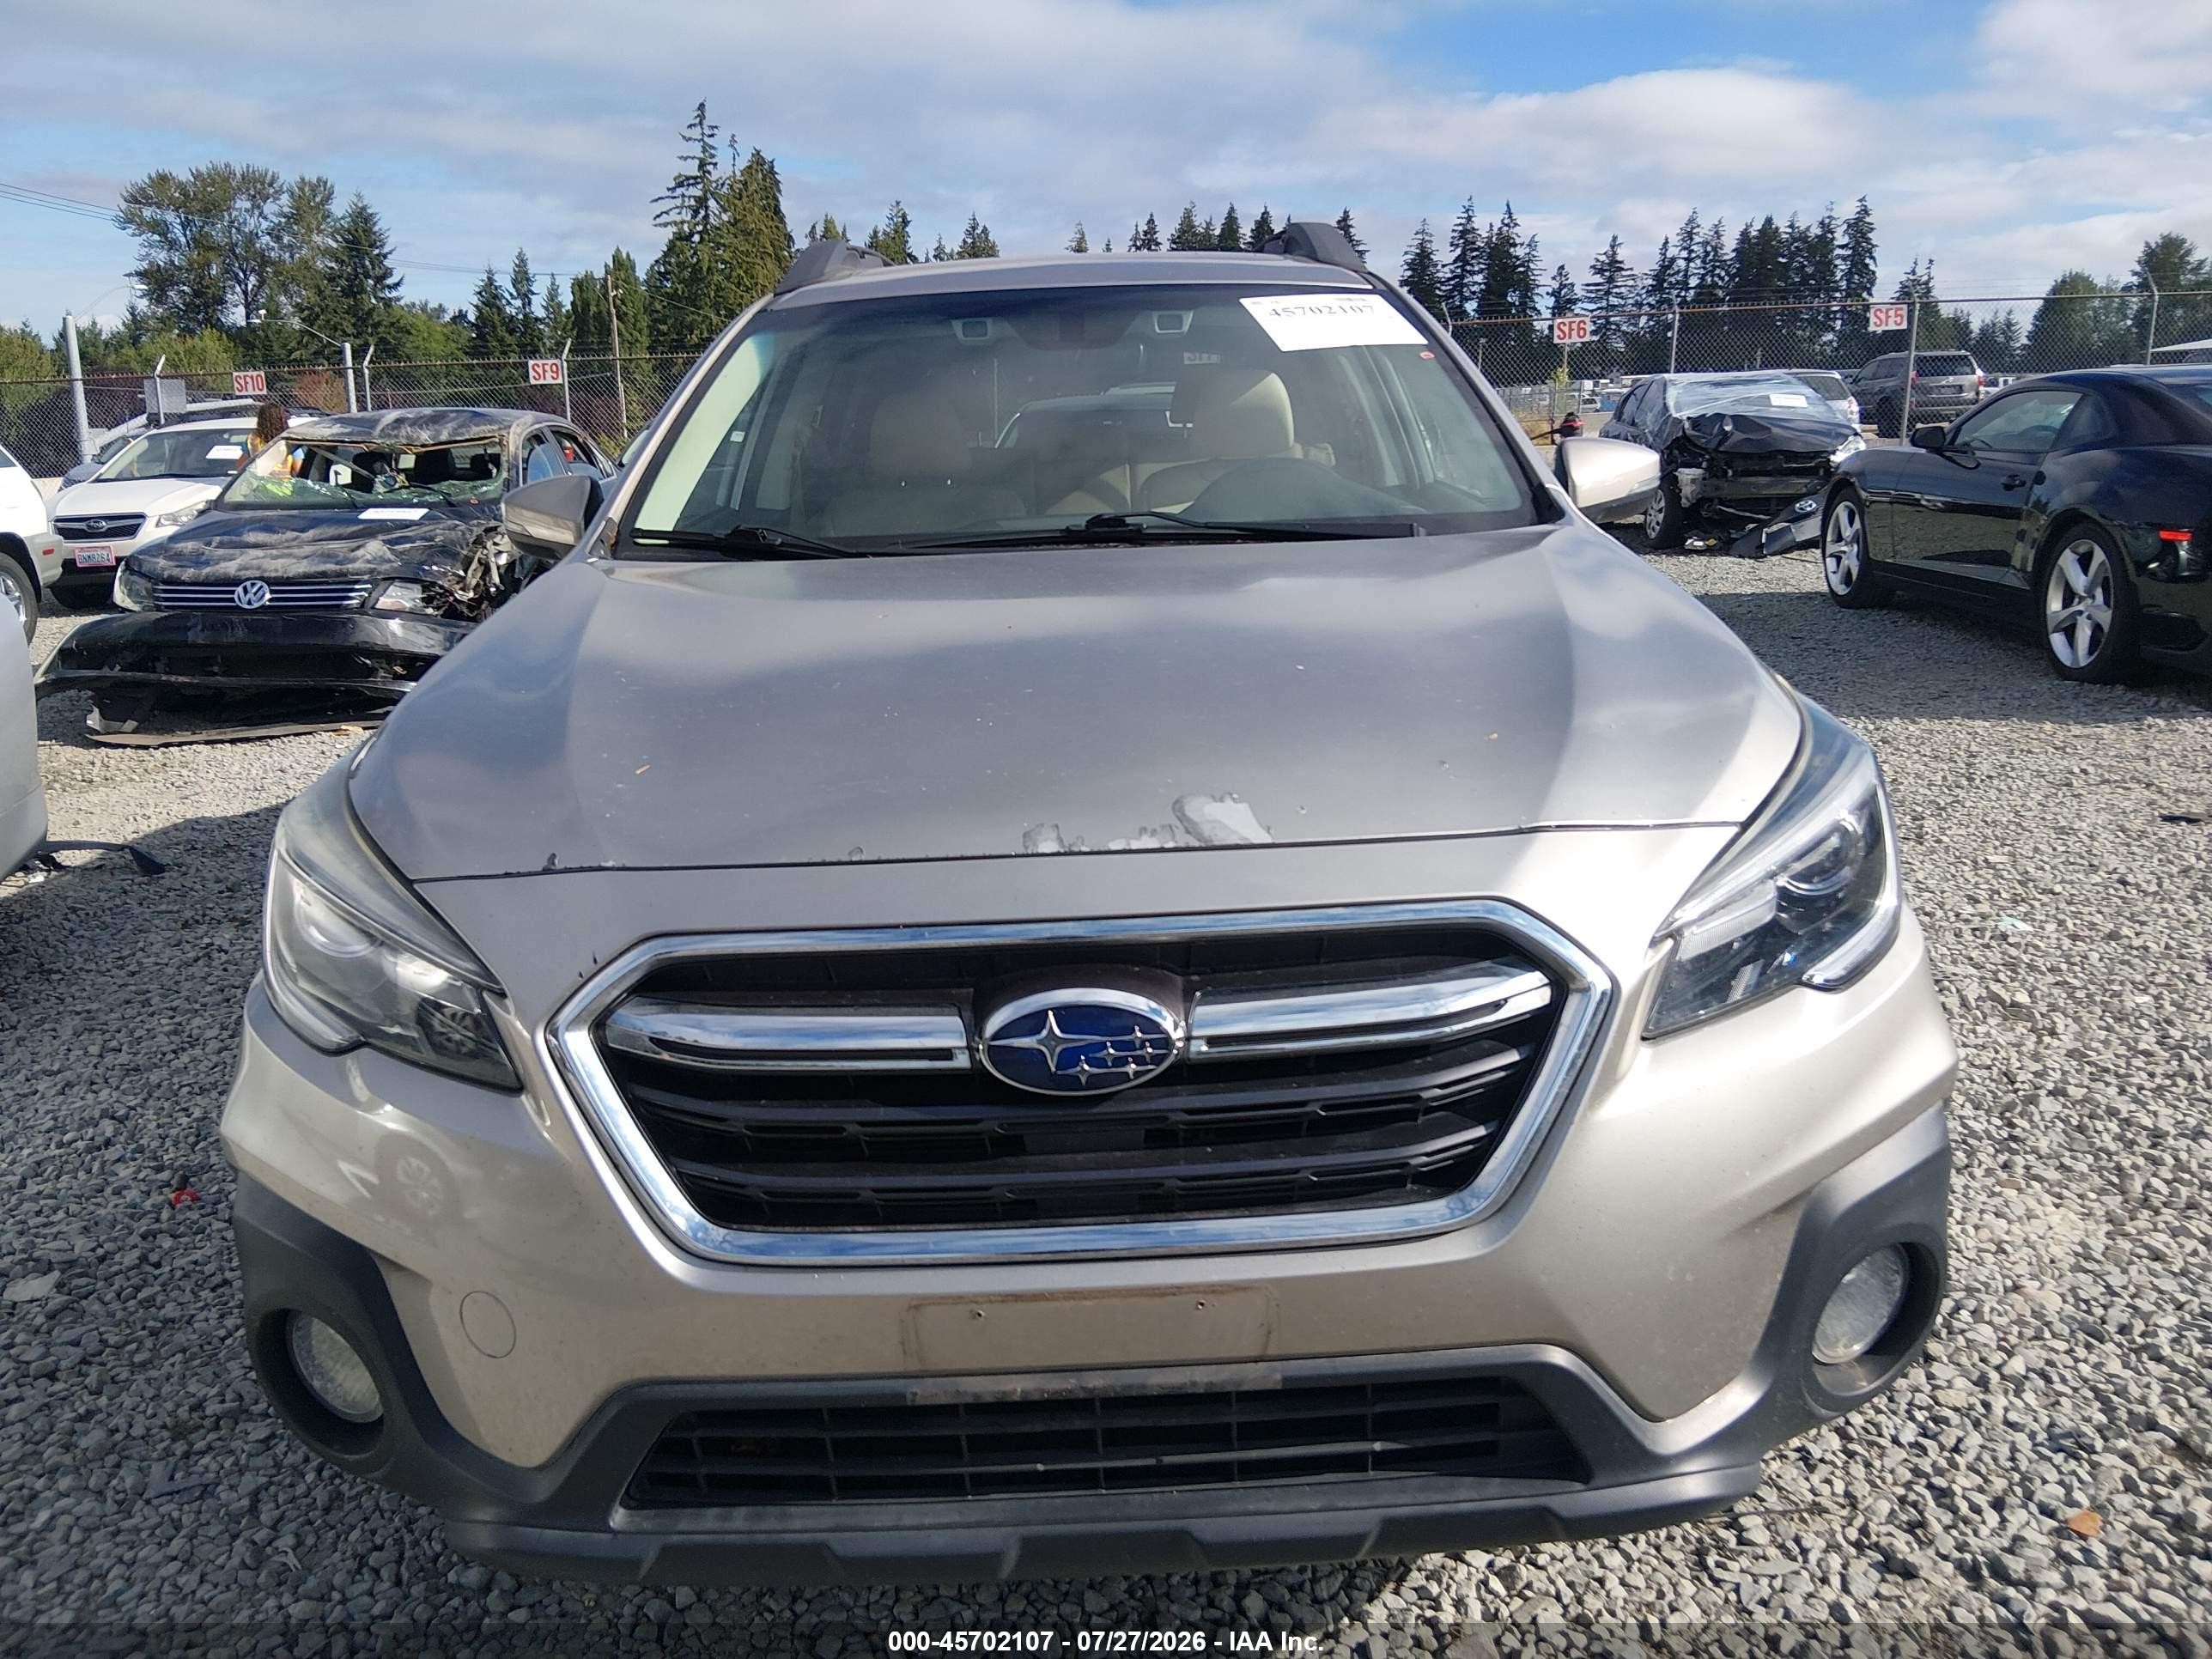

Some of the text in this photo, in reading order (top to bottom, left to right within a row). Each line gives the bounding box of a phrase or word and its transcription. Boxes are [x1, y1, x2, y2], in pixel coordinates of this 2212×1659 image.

[1873, 307, 1904, 327] SF5
[1556, 319, 1587, 341] SF6
[532, 362, 560, 380] SF9
[234, 374, 264, 392] SF10
